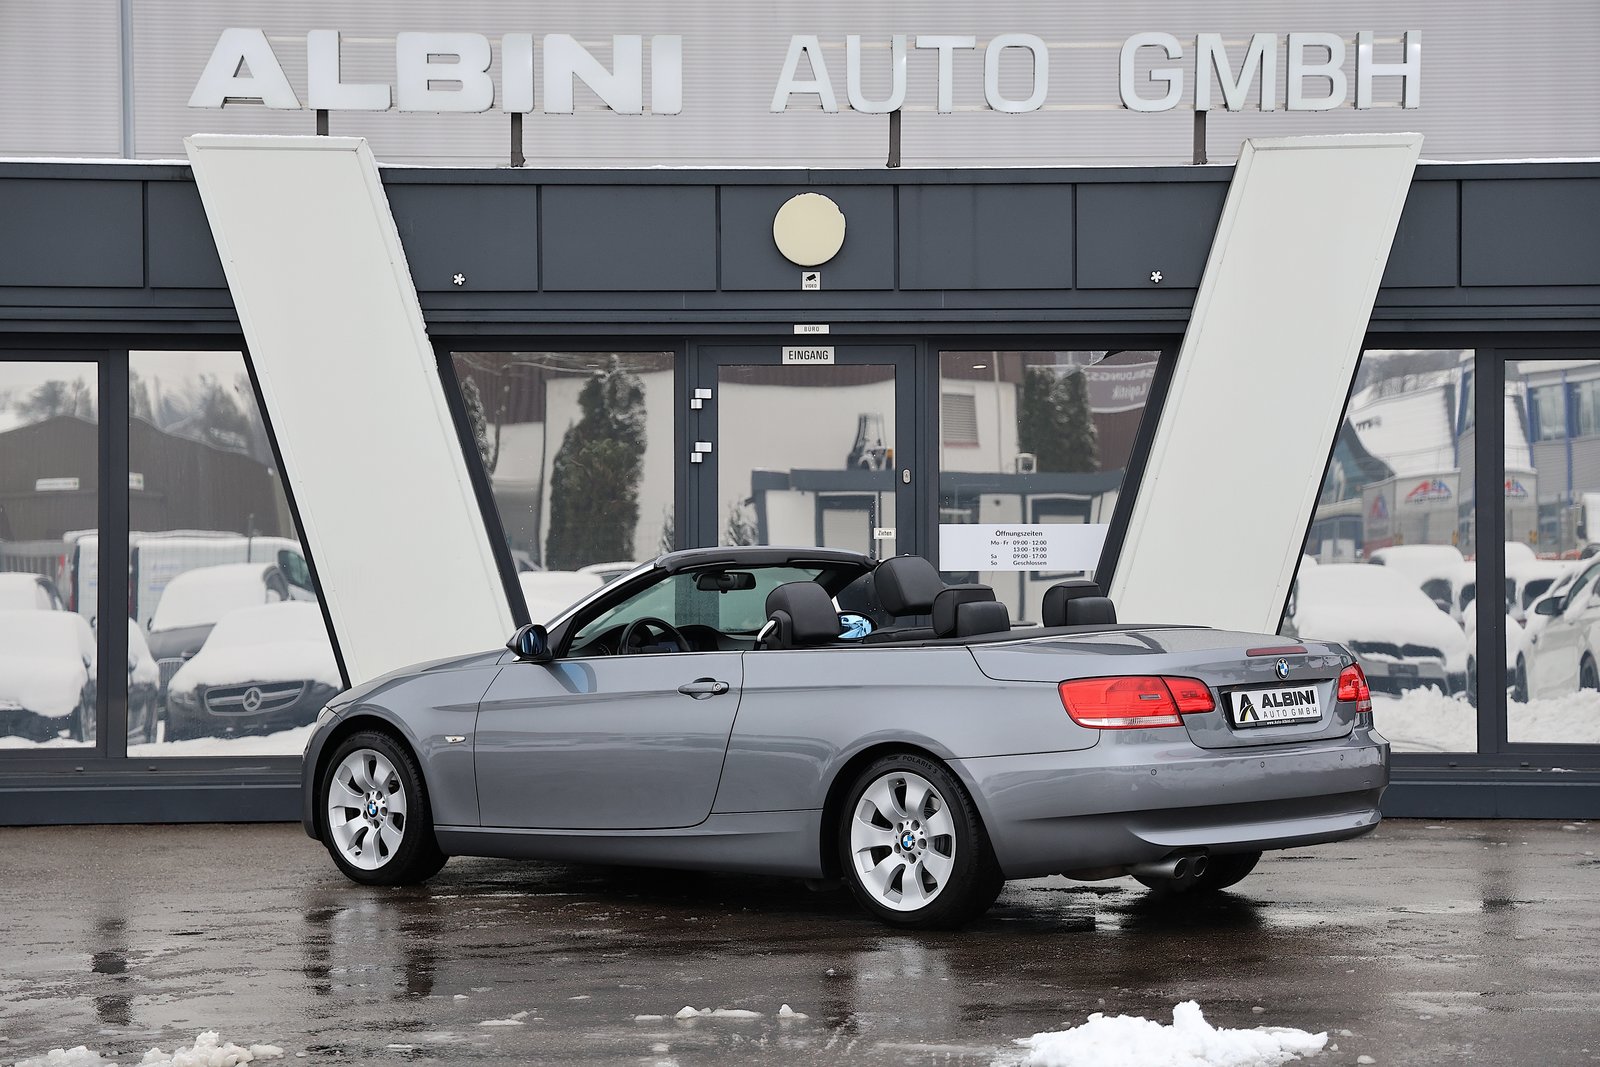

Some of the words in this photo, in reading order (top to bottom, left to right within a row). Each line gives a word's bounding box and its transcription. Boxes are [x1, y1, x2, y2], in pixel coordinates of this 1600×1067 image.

[188, 28, 683, 115] ALBINI
[770, 33, 1049, 114] AUTO
[1119, 30, 1422, 112] GMBH
[788, 350, 829, 360] EINGANG
[995, 530, 1043, 538] Öffnungszeiten
[1262, 690, 1316, 708] ALBINI
[1263, 709, 1288, 719] AUTO
[1291, 706, 1318, 716] GMBH
[902, 755, 933, 770] POLARIS
